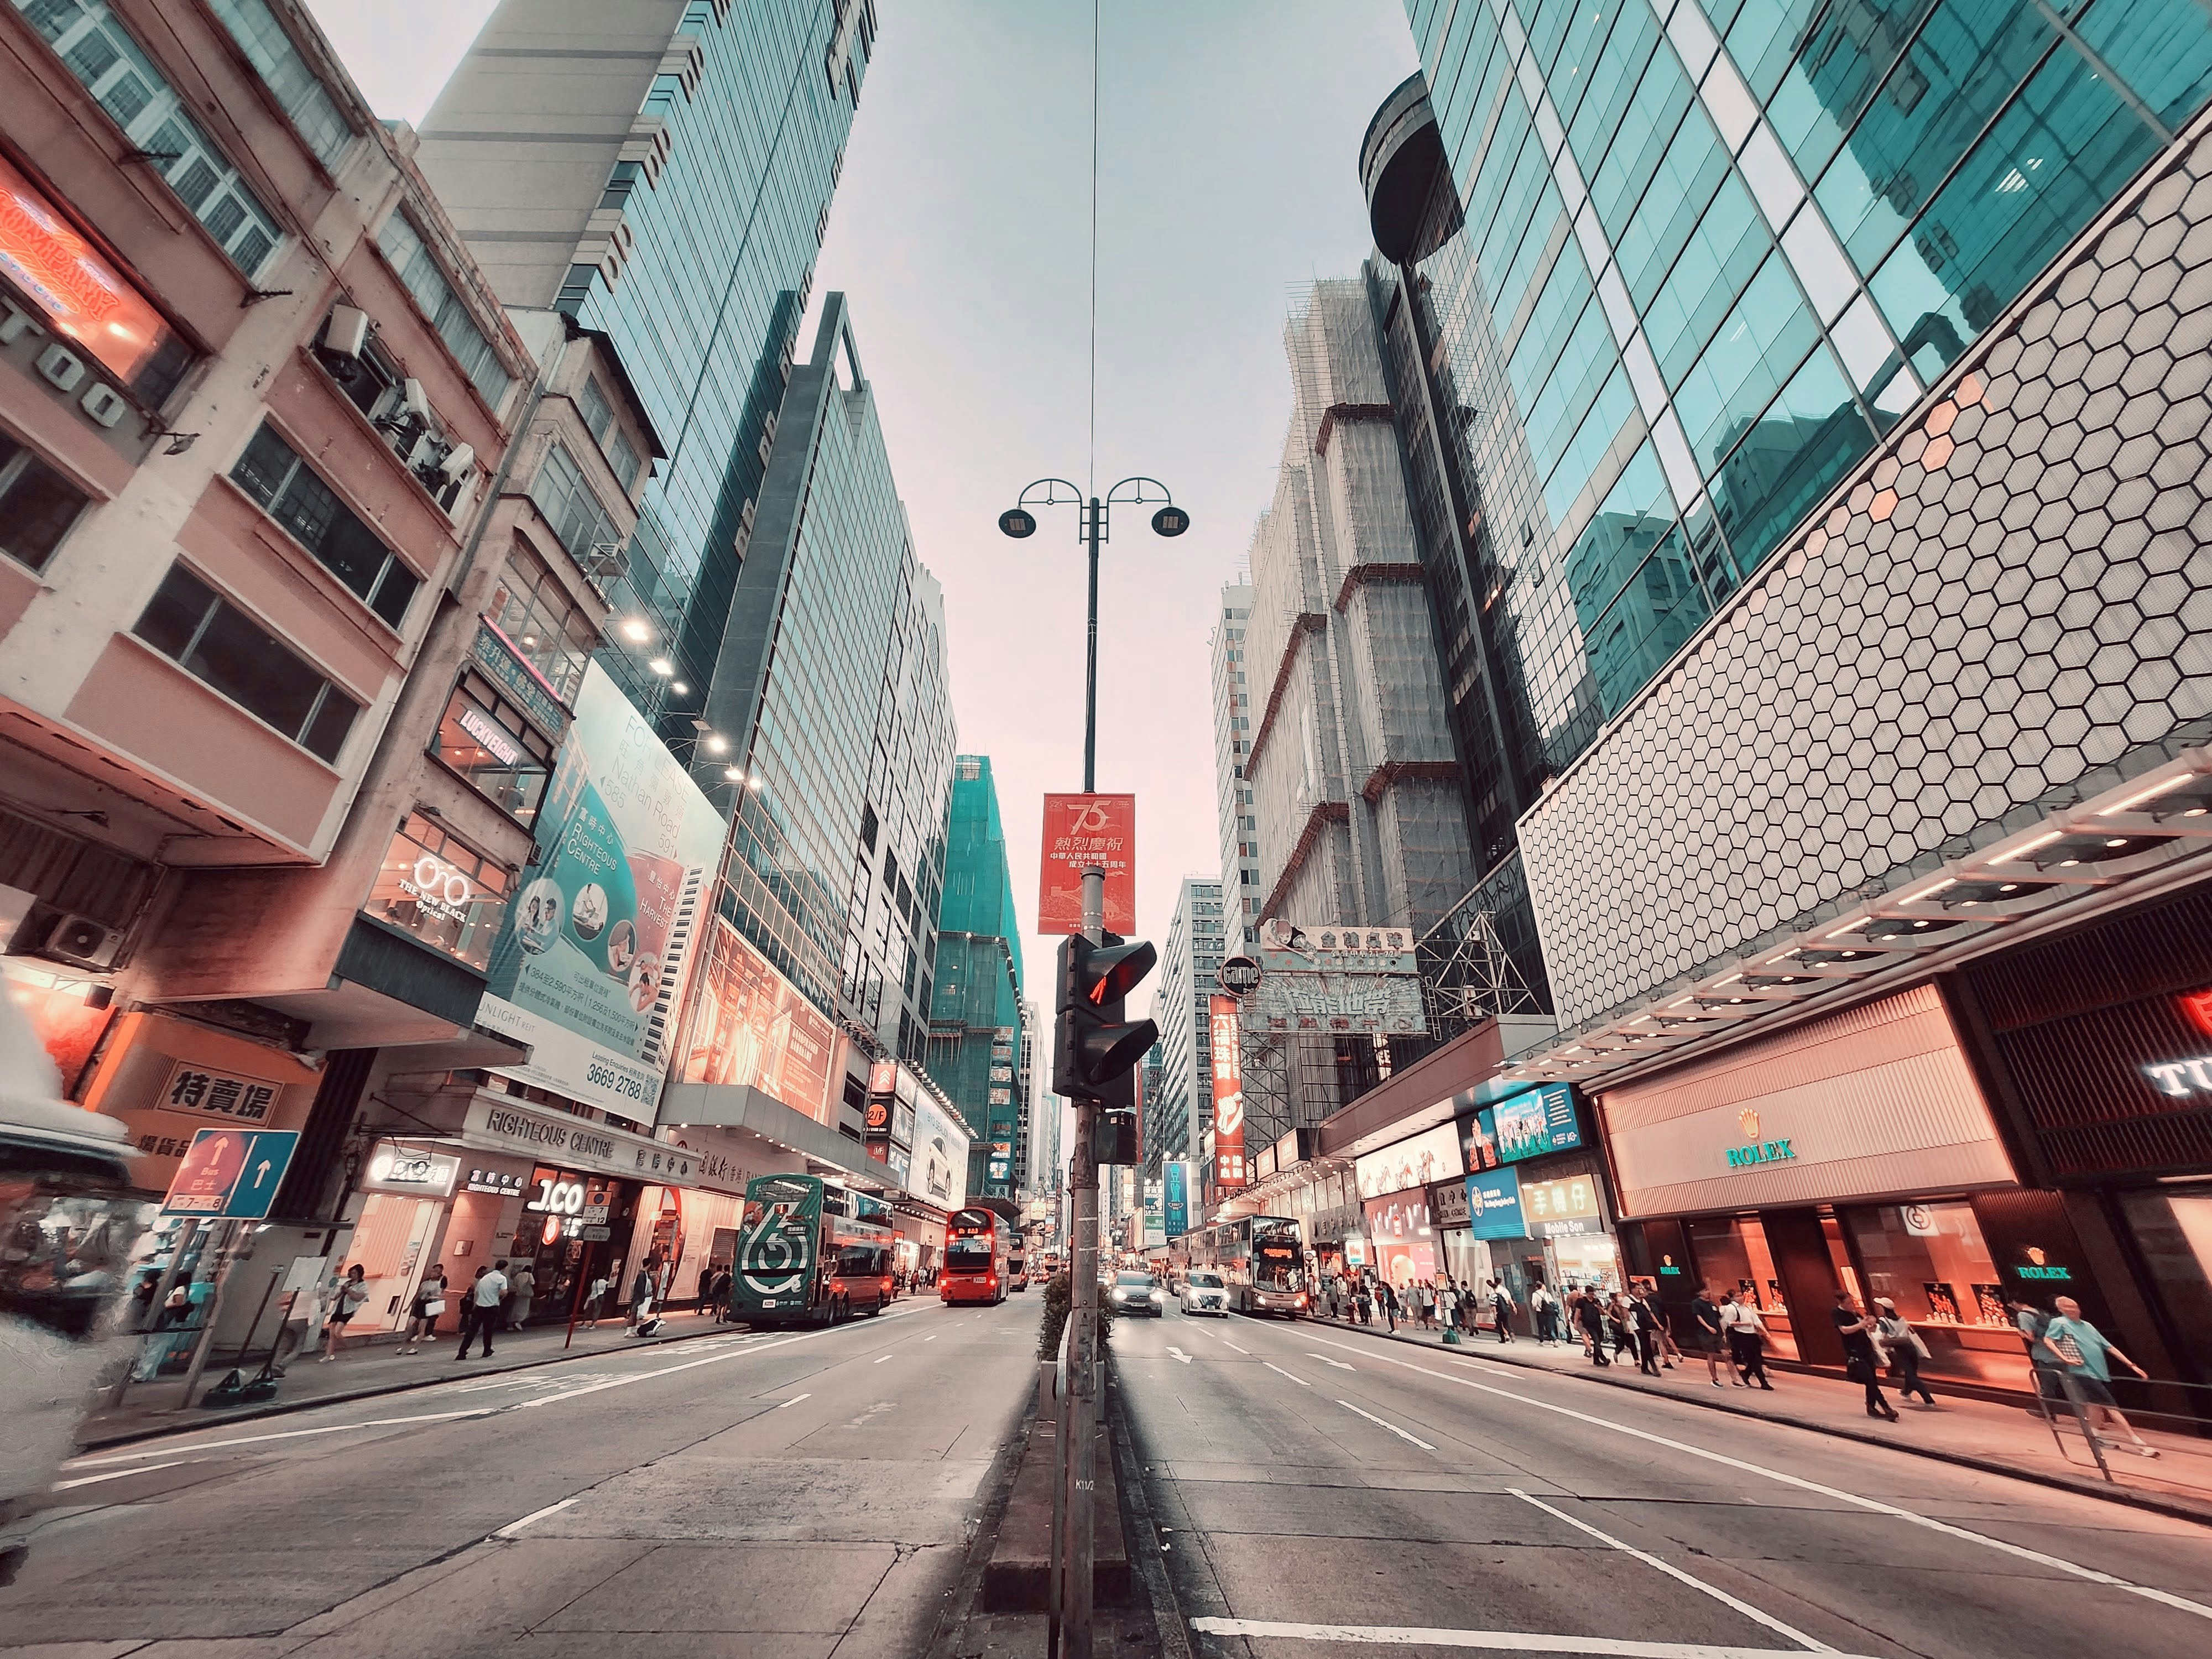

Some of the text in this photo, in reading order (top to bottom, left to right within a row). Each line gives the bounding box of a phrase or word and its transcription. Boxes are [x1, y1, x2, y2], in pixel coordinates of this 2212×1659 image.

[460, 709, 518, 765] LUCKYEIGHT
[625, 715, 691, 804] FOR LEASE
[605, 779, 626, 808] 585
[612, 756, 680, 839] Nathan Road
[578, 806, 614, 846] 富時中心
[1066, 800, 1112, 836] 75
[658, 833, 674, 857] 591
[1053, 837, 1124, 851] 熱烈慶祝
[1069, 860, 1126, 869] 成立七十五周年
[399, 879, 467, 923] THE NEW BLACK
[415, 900, 446, 921] Optical
[639, 897, 669, 930] HARVEST
[659, 895, 672, 918] THE
[1212, 1014, 1231, 1079] 六福珠寶
[592, 1051, 609, 1066] Leasing
[609, 1058, 629, 1073] Enquiries
[587, 1063, 615, 1089] 3669
[615, 1075, 641, 1100] 2788
[171, 1071, 274, 1119] 特賣場
[868, 1110, 884, 1120] 2/F
[487, 1108, 566, 1146] RIGHTEOUS
[570, 1131, 616, 1159] CENTRE
[1726, 1138, 1796, 1167] ROLEX
[201, 1167, 220, 1176] Bus
[190, 1179, 217, 1191] 巴士
[499, 1187, 521, 1197] CENTRE
[527, 1179, 585, 1215] J.CO
[1545, 1221, 1584, 1234] Mobile Son
[1287, 1249, 1292, 1259] 6
[1660, 1266, 1681, 1275] ROLEX
[2018, 1266, 2071, 1279] ROLEX
